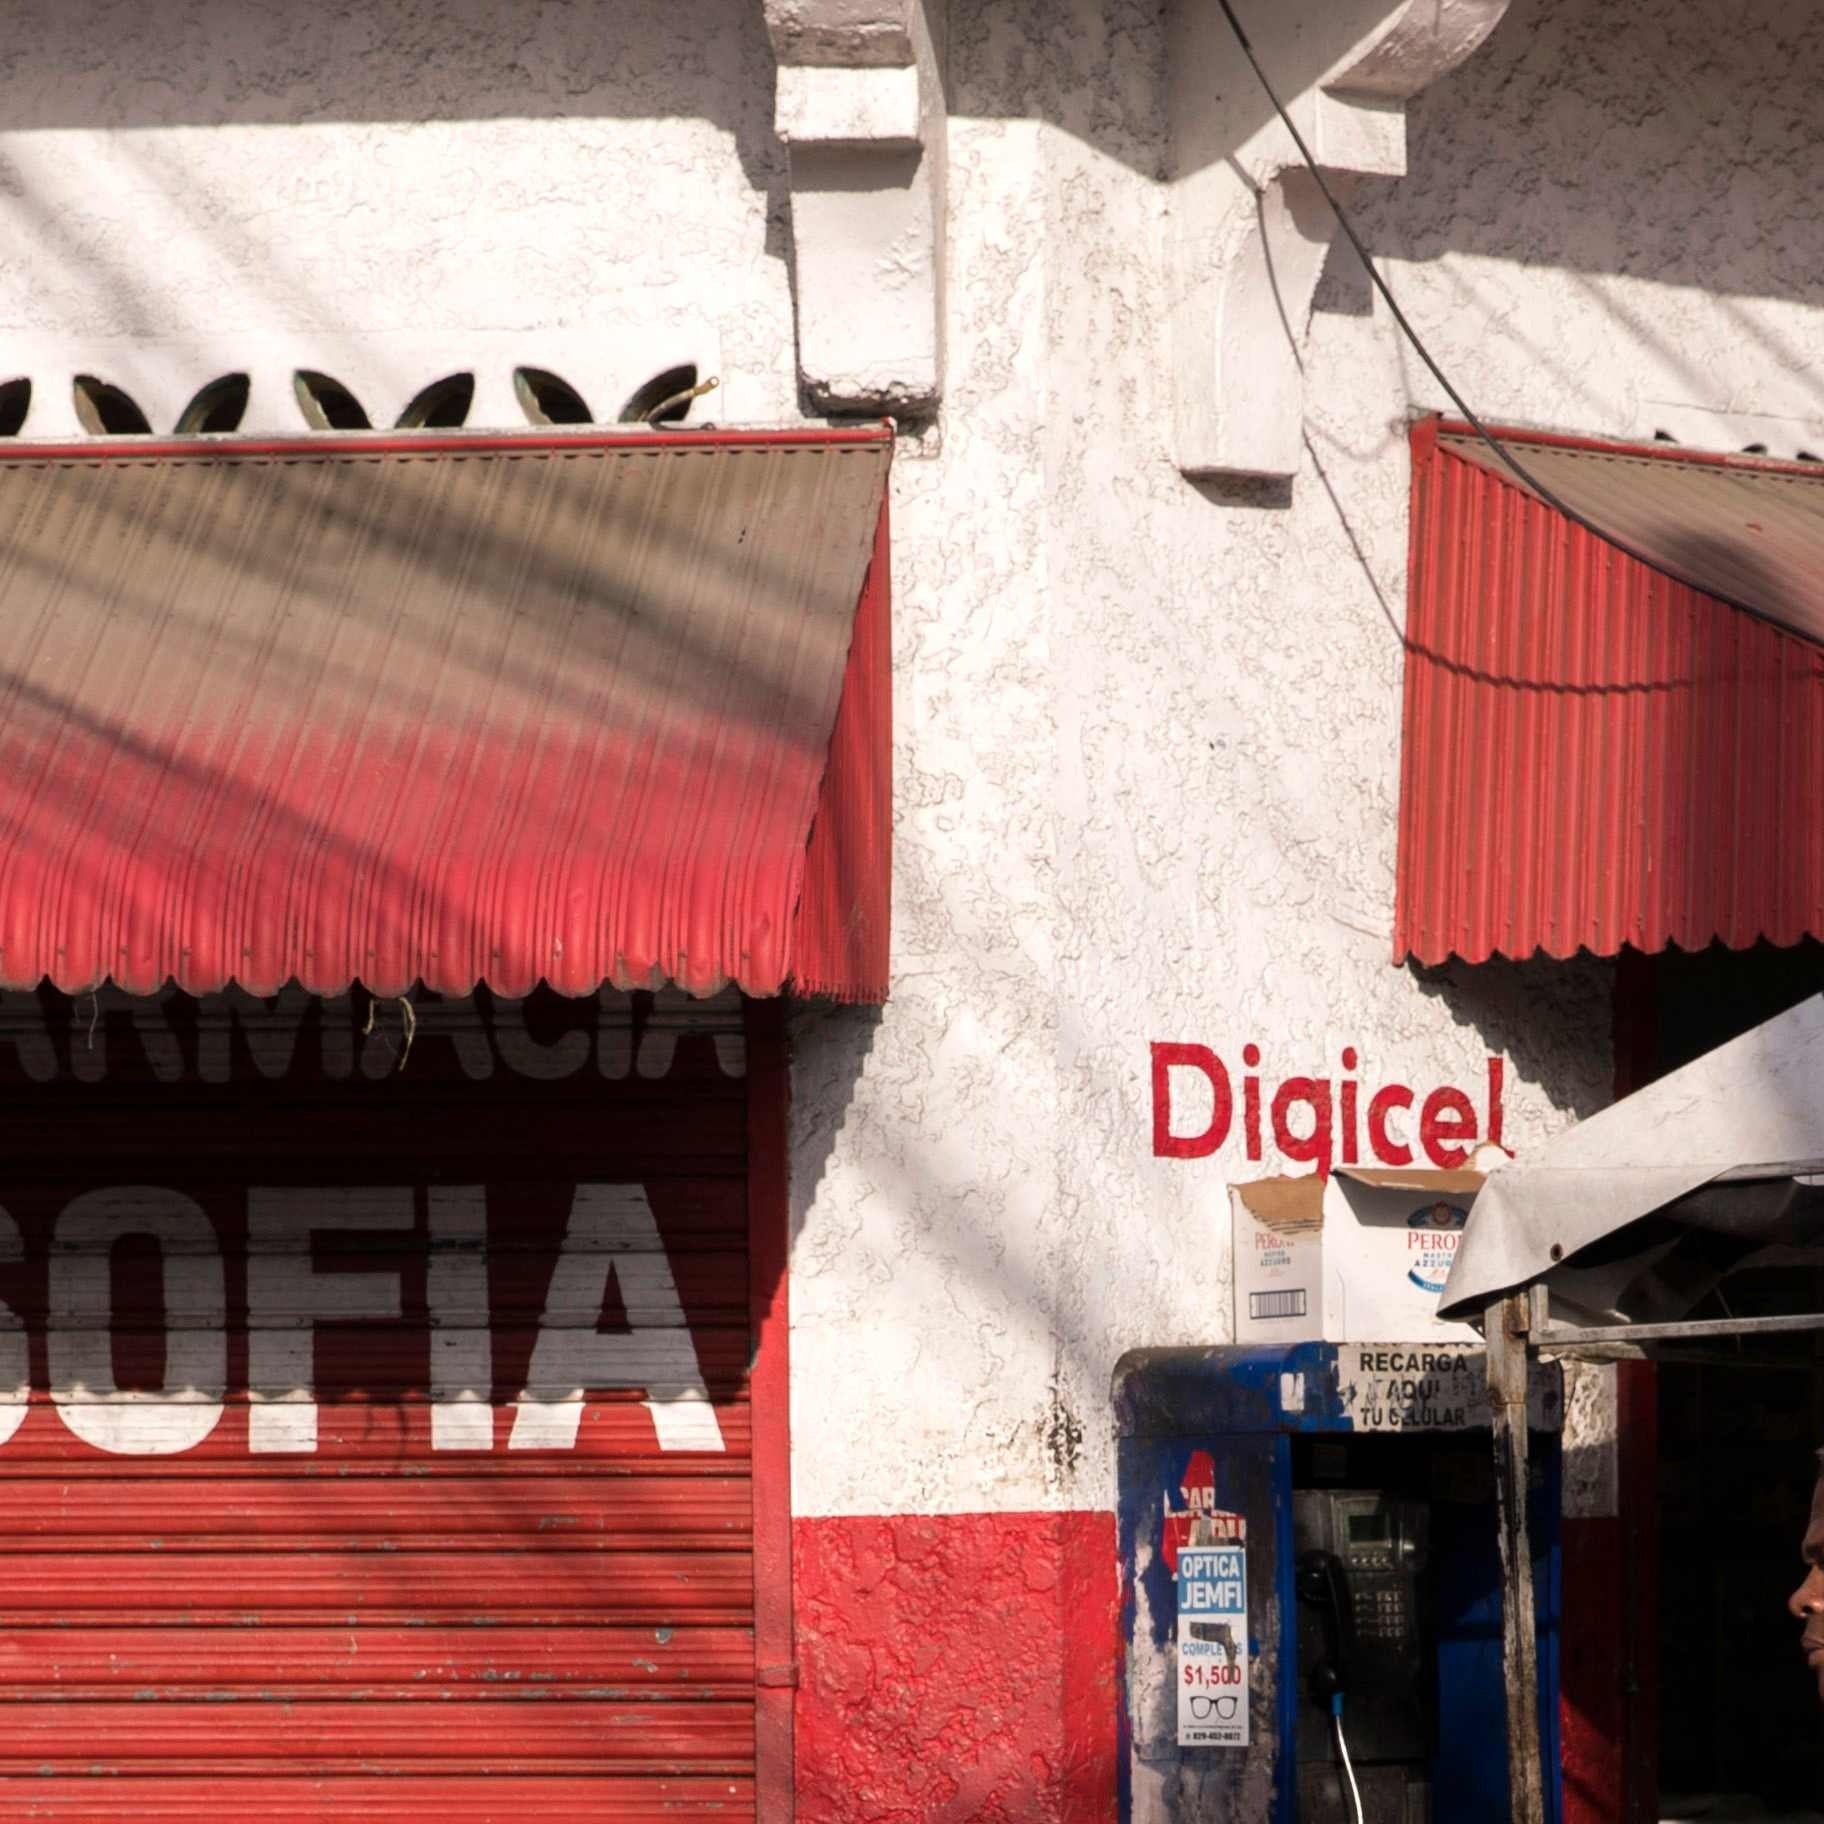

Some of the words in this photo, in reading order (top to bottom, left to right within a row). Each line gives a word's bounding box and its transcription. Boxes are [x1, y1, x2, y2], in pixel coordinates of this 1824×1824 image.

[1149, 1041, 1515, 1184] Digicel
[1360, 1353, 1467, 1372] RECARGA
[1360, 1408, 1383, 1426] TU
[1182, 1556, 1240, 1579] OPTICA
[1181, 1581, 1242, 1609] JEMFI
[1182, 1642, 1243, 1656] COMPLES
[1184, 1664, 1241, 1690] $1,500
